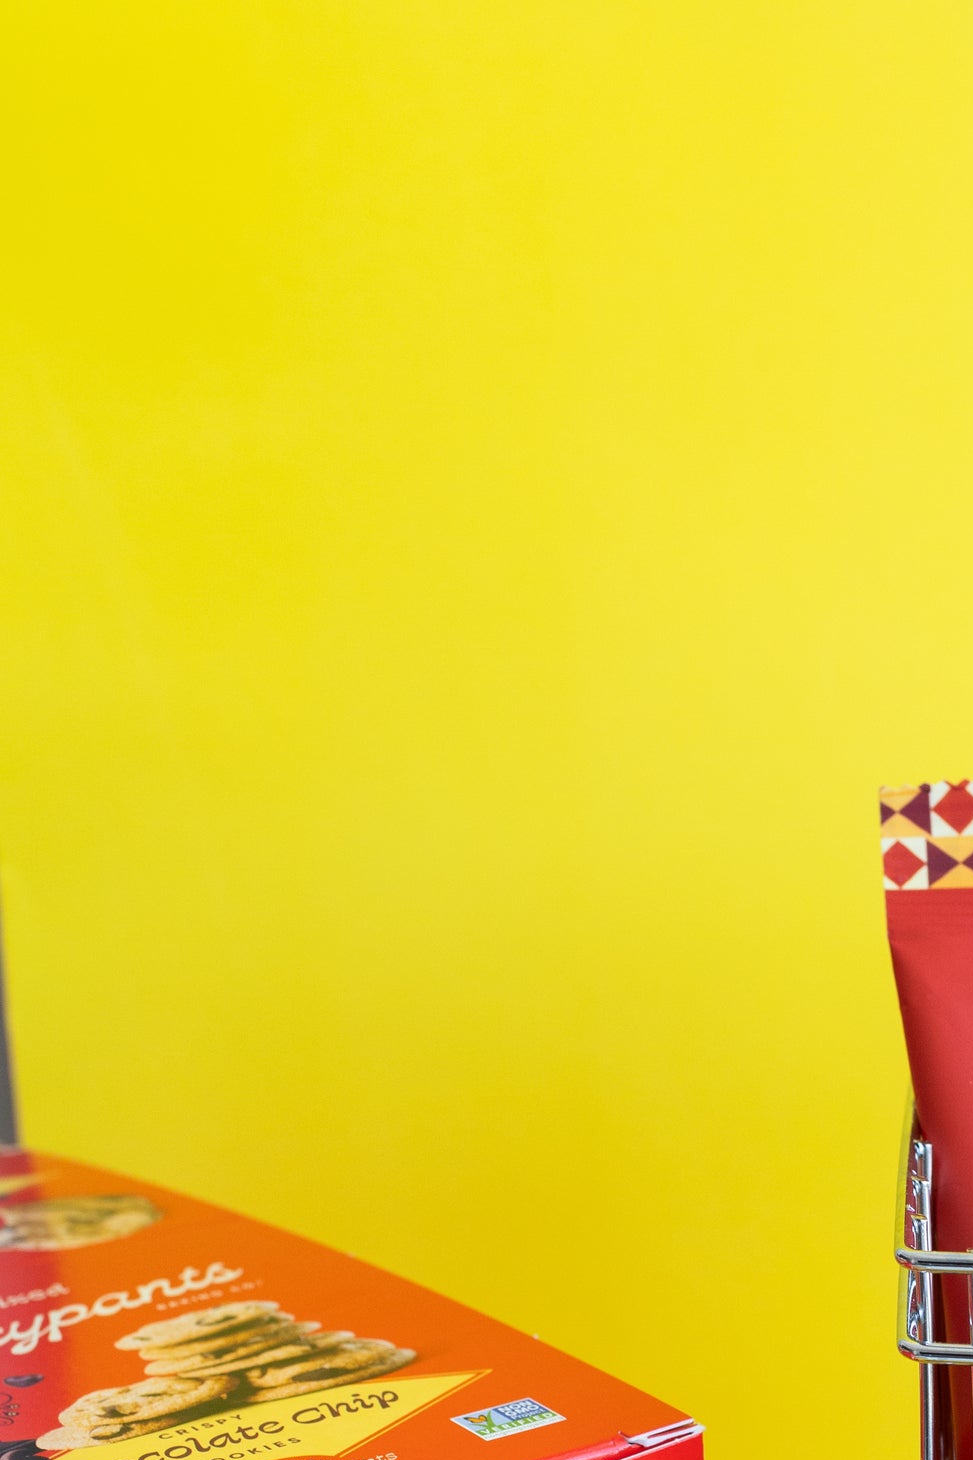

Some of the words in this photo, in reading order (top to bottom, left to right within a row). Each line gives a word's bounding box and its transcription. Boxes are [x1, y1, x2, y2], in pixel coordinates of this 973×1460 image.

[0, 1262, 243, 1355] ypants
[291, 1388, 399, 1425] Chip
[158, 1414, 243, 1440] CRISPY
